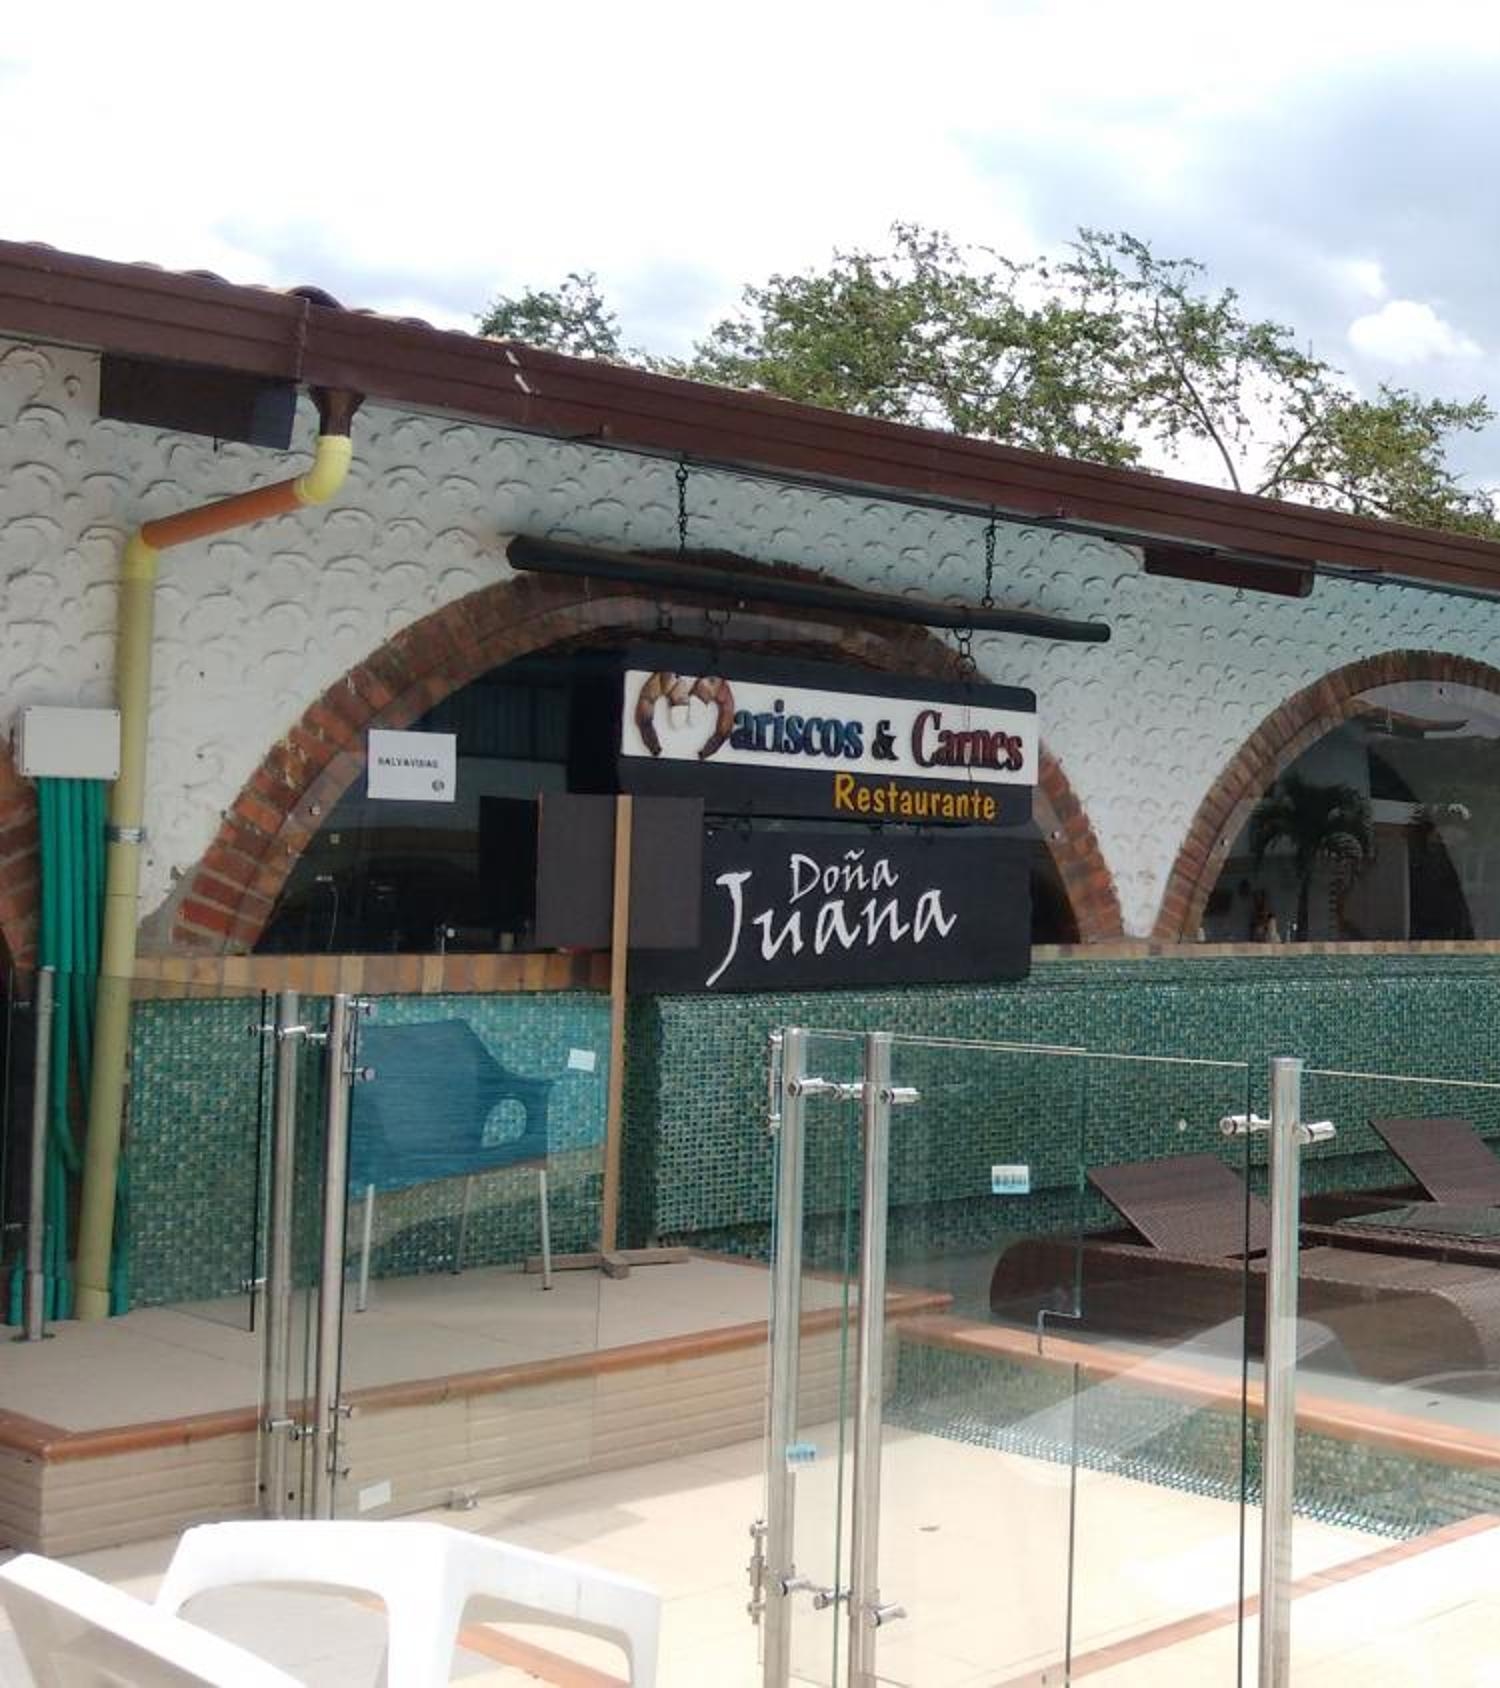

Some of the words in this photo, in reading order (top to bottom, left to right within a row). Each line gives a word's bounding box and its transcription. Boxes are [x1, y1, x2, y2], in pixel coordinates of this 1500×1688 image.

[871, 719, 899, 761] &
[911, 709, 1023, 771] Carnes
[834, 773, 996, 820] Restaurante
[789, 849, 899, 904] Doña
[706, 870, 957, 987] Juana
